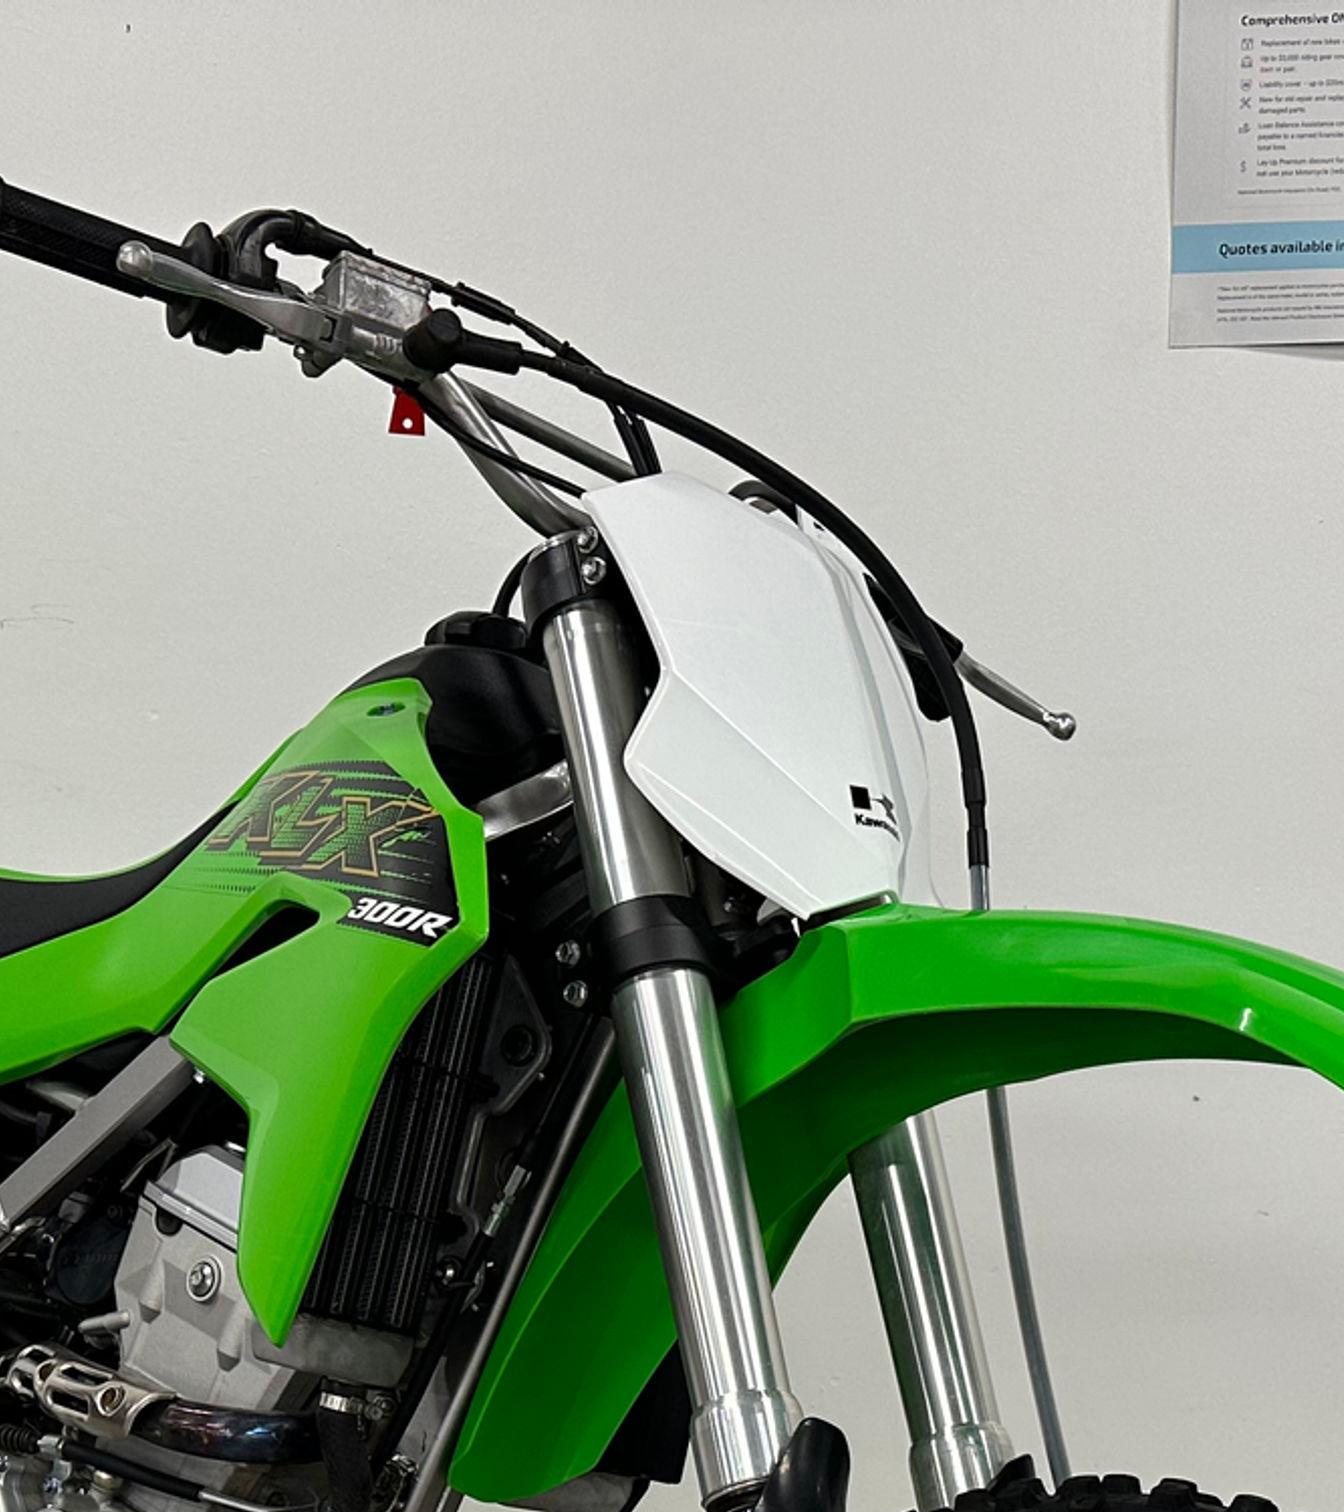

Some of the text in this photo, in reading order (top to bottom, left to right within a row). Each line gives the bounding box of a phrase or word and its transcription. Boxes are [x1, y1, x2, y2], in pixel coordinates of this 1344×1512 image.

[1242, 14, 1328, 26] Comprehensive
[1219, 243, 1267, 258] Quotes
[1270, 240, 1332, 253] available
[348, 897, 453, 938] 300R
